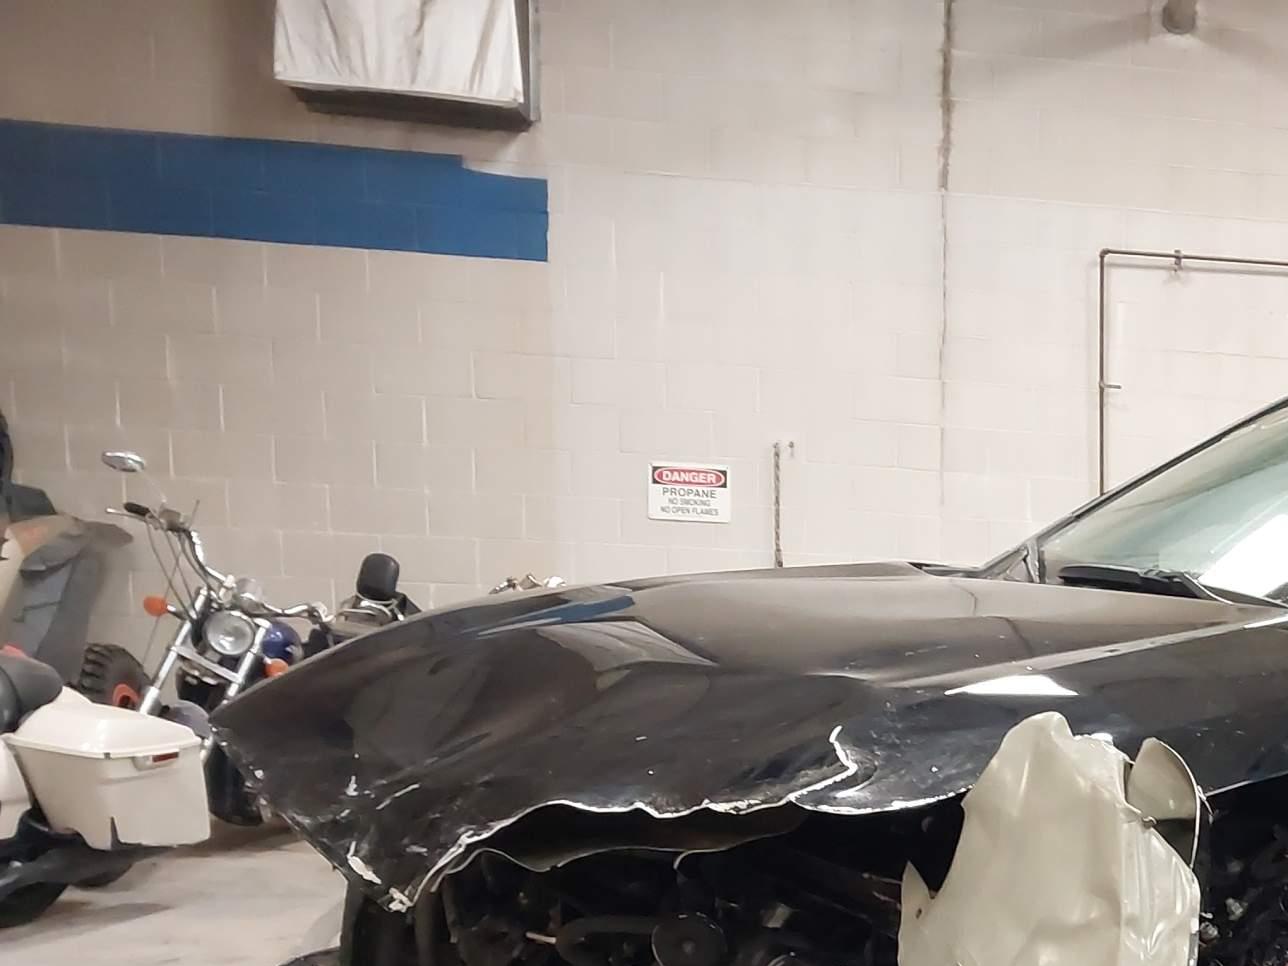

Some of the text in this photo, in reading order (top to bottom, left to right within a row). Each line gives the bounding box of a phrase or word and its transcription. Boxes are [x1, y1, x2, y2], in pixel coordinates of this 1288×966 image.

[662, 470, 717, 484] DANGER
[662, 487, 717, 498] PROPANE
[680, 498, 711, 507] SMOKING
[672, 506, 690, 514] OPEN
[692, 507, 719, 516] FLAMES
